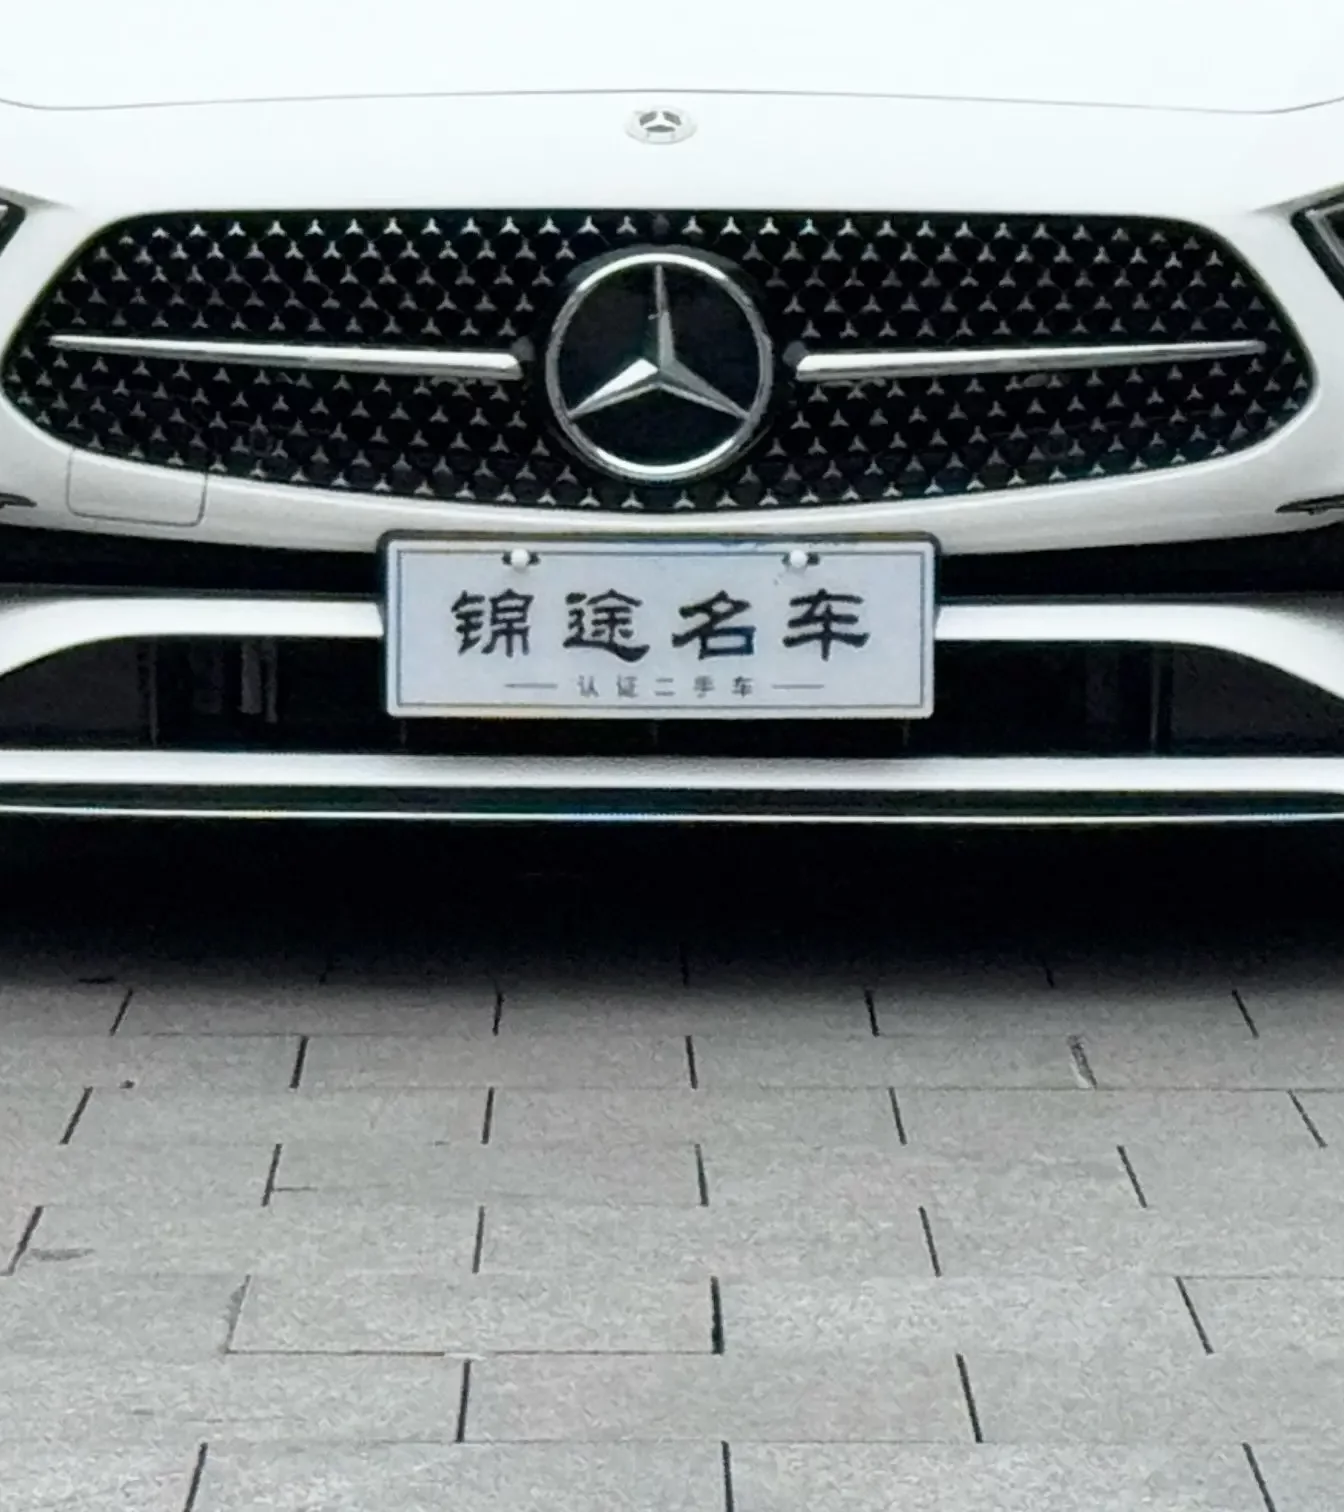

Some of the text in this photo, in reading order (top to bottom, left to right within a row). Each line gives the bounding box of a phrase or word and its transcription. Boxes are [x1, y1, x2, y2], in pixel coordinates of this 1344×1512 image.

[452, 588, 869, 661] 锦途名车
[577, 675, 754, 698] 认证二手车
